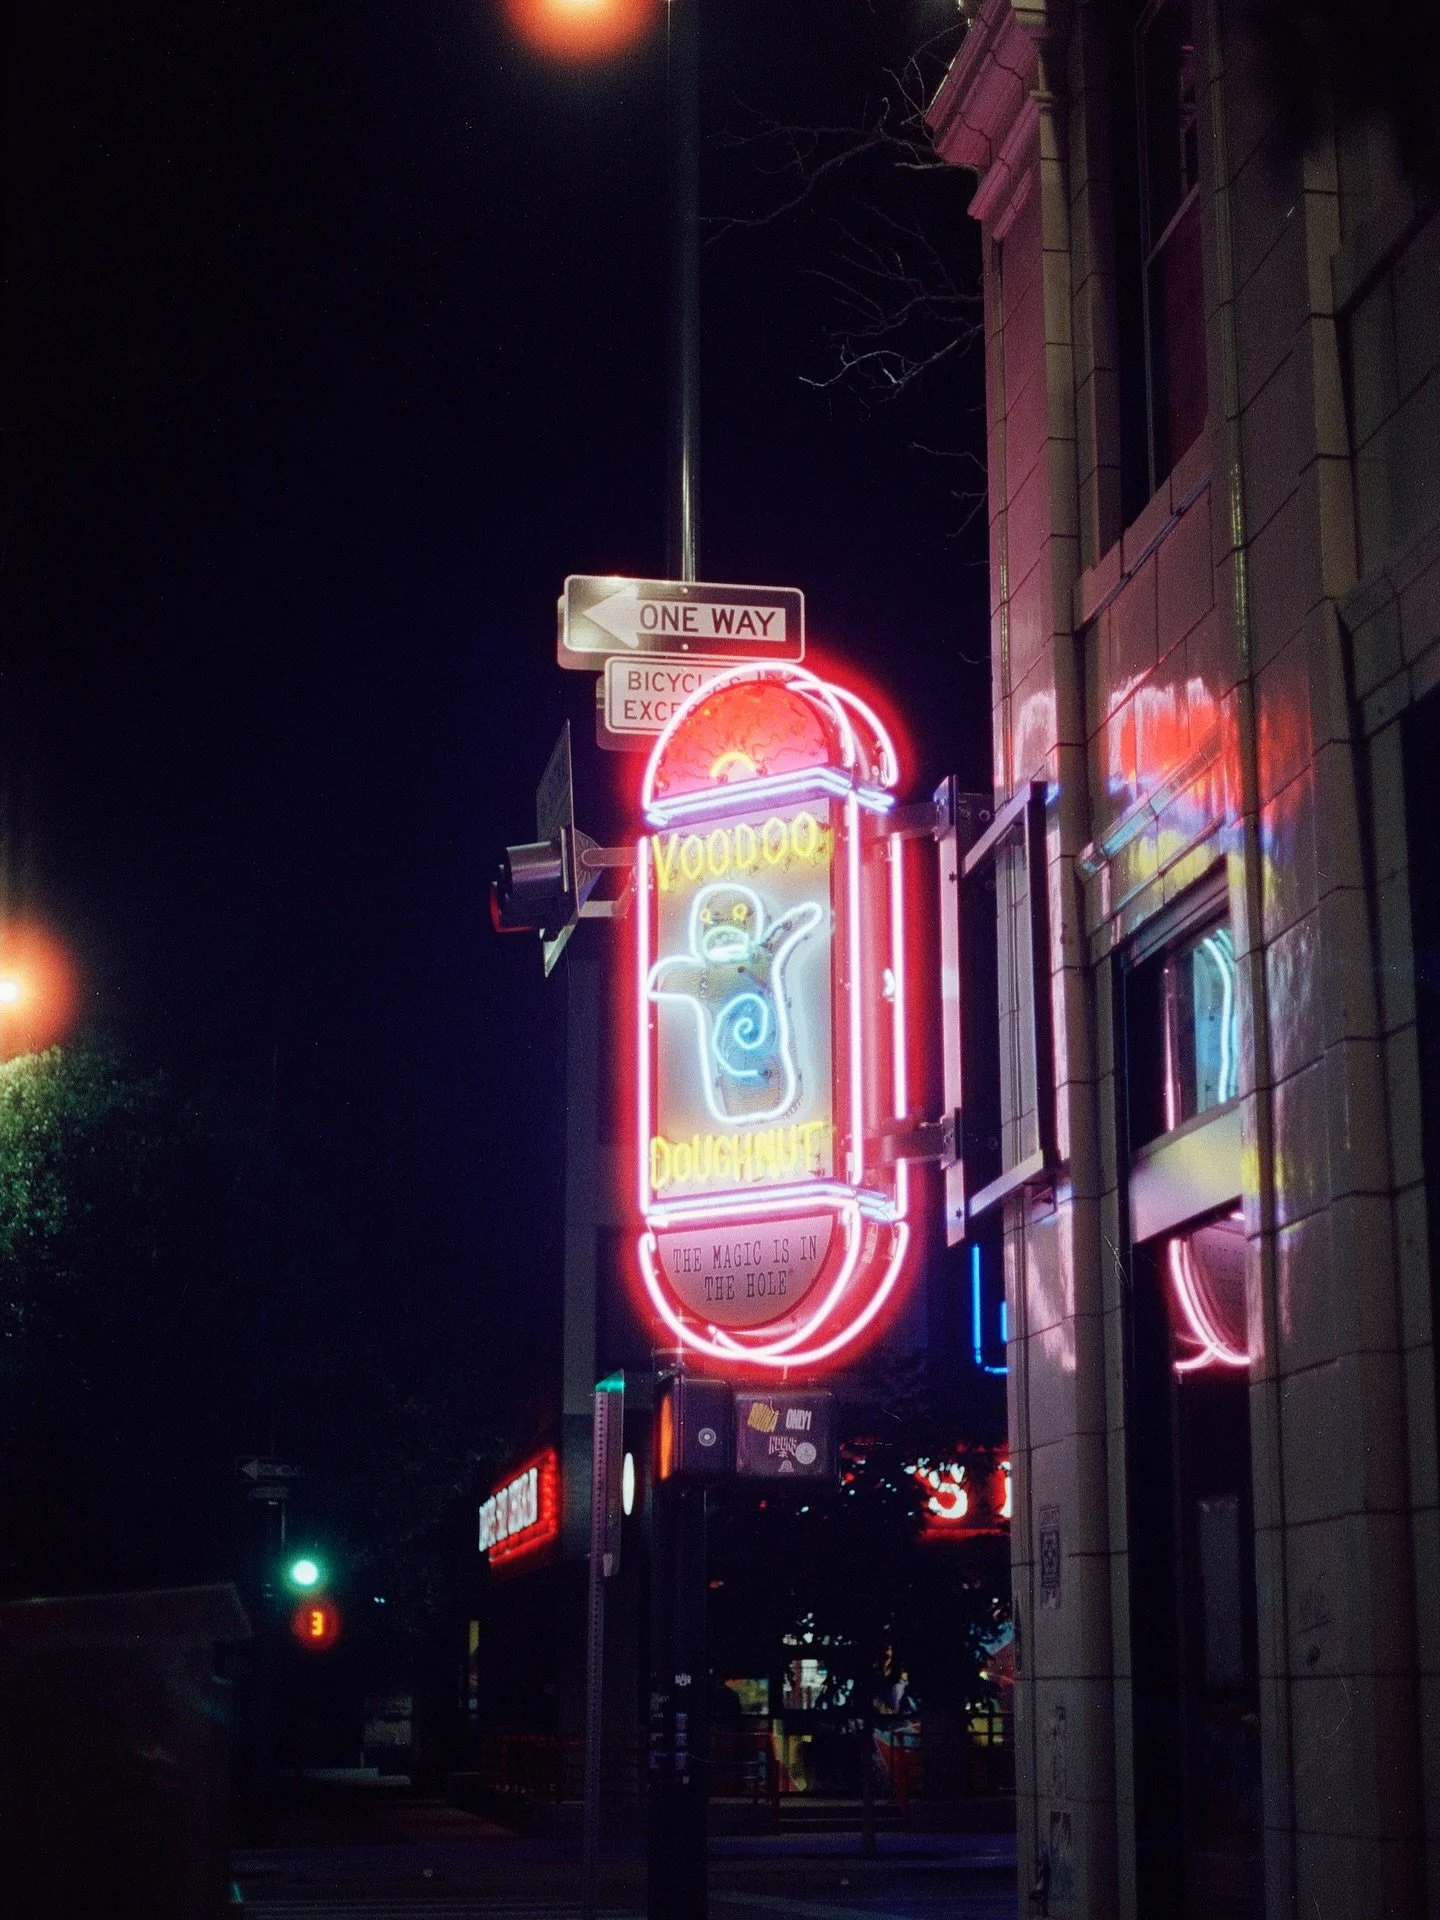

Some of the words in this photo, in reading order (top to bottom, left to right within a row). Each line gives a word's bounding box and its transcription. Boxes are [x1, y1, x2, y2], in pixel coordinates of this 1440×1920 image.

[640, 604, 699, 633] ONE
[712, 607, 776, 637] WAY
[652, 811, 819, 890] VOODOO
[652, 1120, 823, 1189] DOUGHNUT
[672, 1248, 702, 1274] THE
[713, 1241, 762, 1270] MAGIC
[773, 1238, 790, 1264] IS
[800, 1235, 817, 1261] IN
[704, 1275, 735, 1301] THE
[311, 1611, 323, 1636] 3
